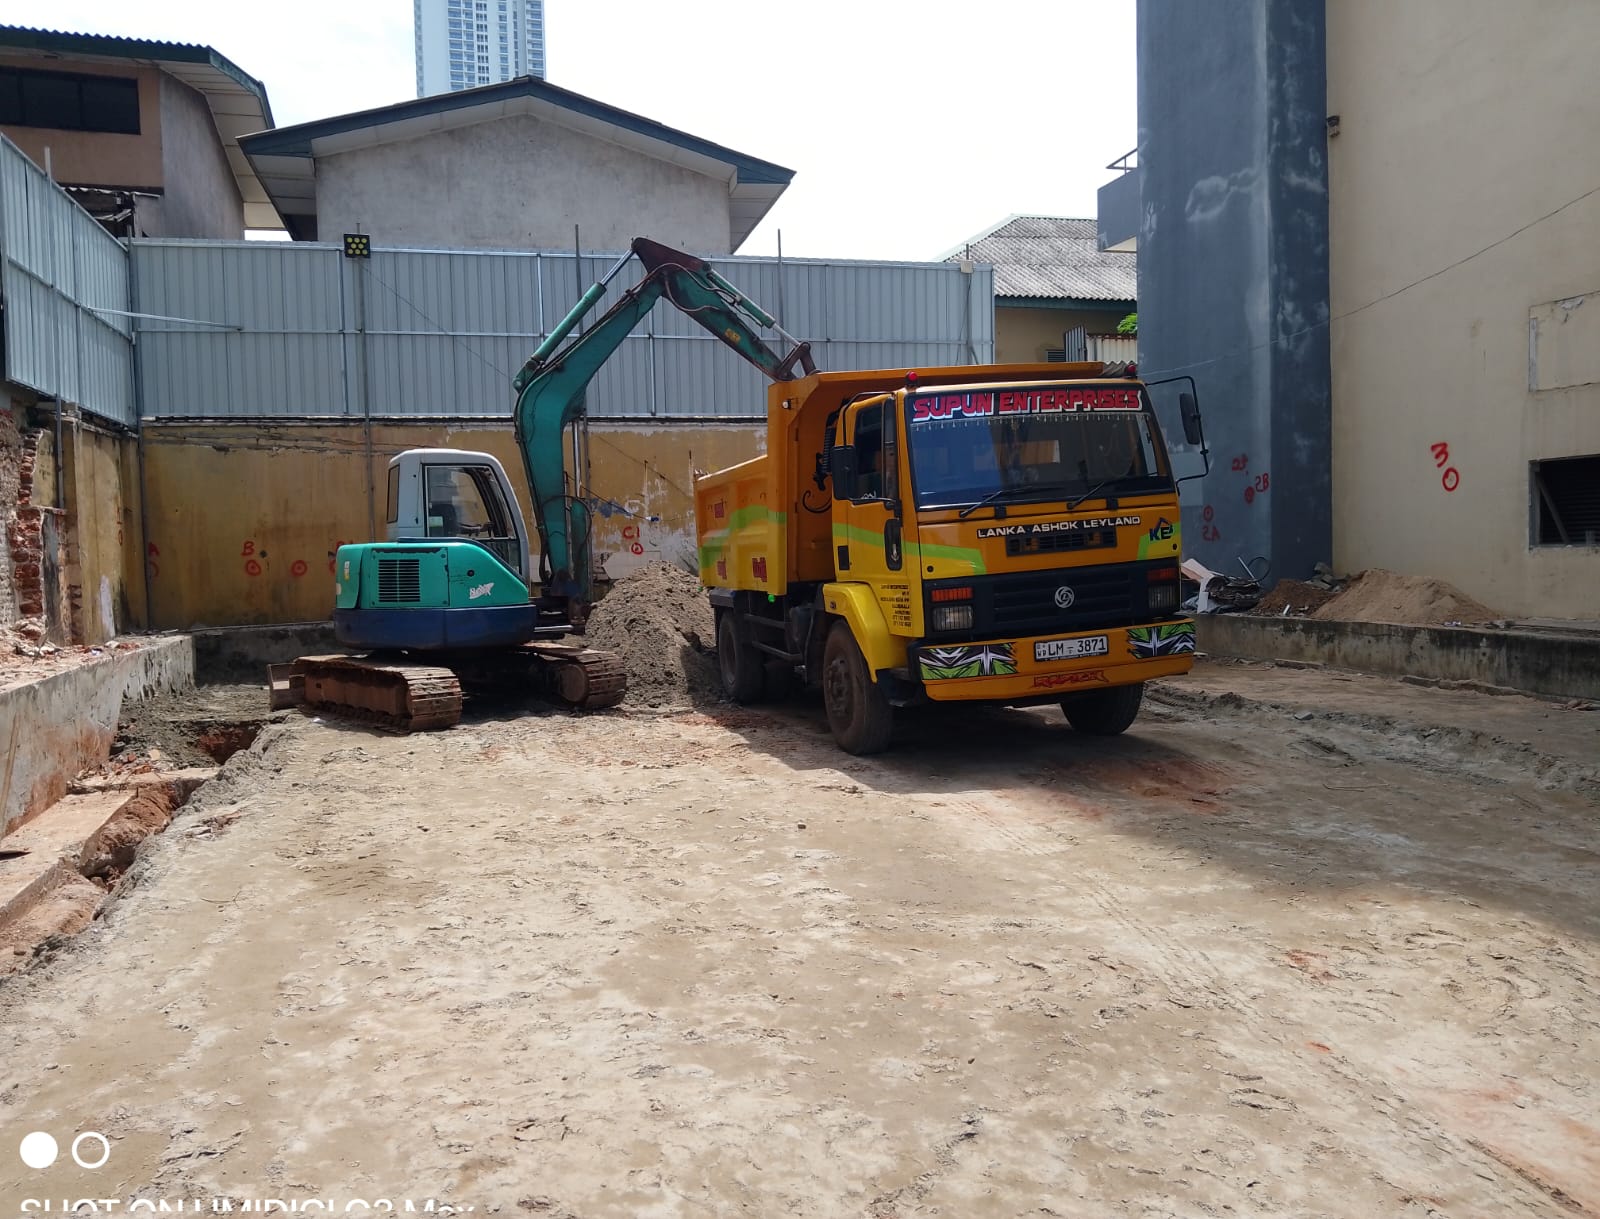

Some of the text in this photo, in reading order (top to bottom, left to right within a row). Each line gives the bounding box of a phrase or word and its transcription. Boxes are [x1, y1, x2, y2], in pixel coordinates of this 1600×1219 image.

[913, 389, 1143, 422] SUPUN ENTERPRISES
[977, 516, 1141, 538] LANKA ASHOK LEYLAND
[1077, 638, 1106, 653] 3871
